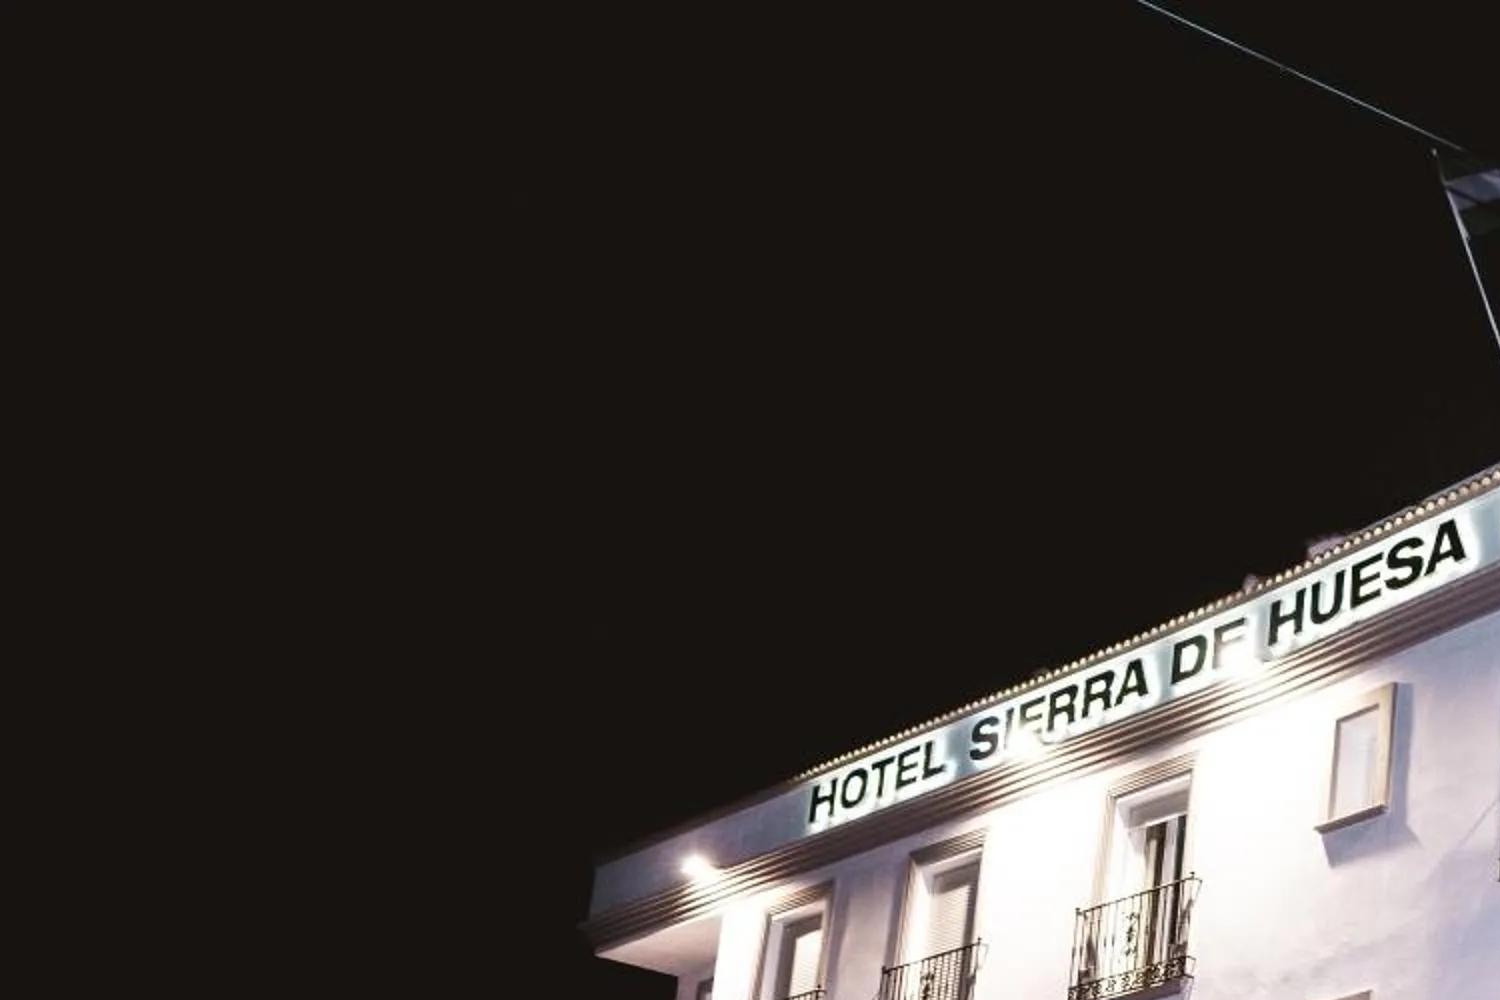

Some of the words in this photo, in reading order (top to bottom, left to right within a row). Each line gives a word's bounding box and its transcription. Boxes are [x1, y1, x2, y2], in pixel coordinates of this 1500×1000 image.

[808, 739, 946, 824] HOTEL
[969, 658, 1149, 761] SIERRA
[1267, 518, 1467, 647] HUESA
